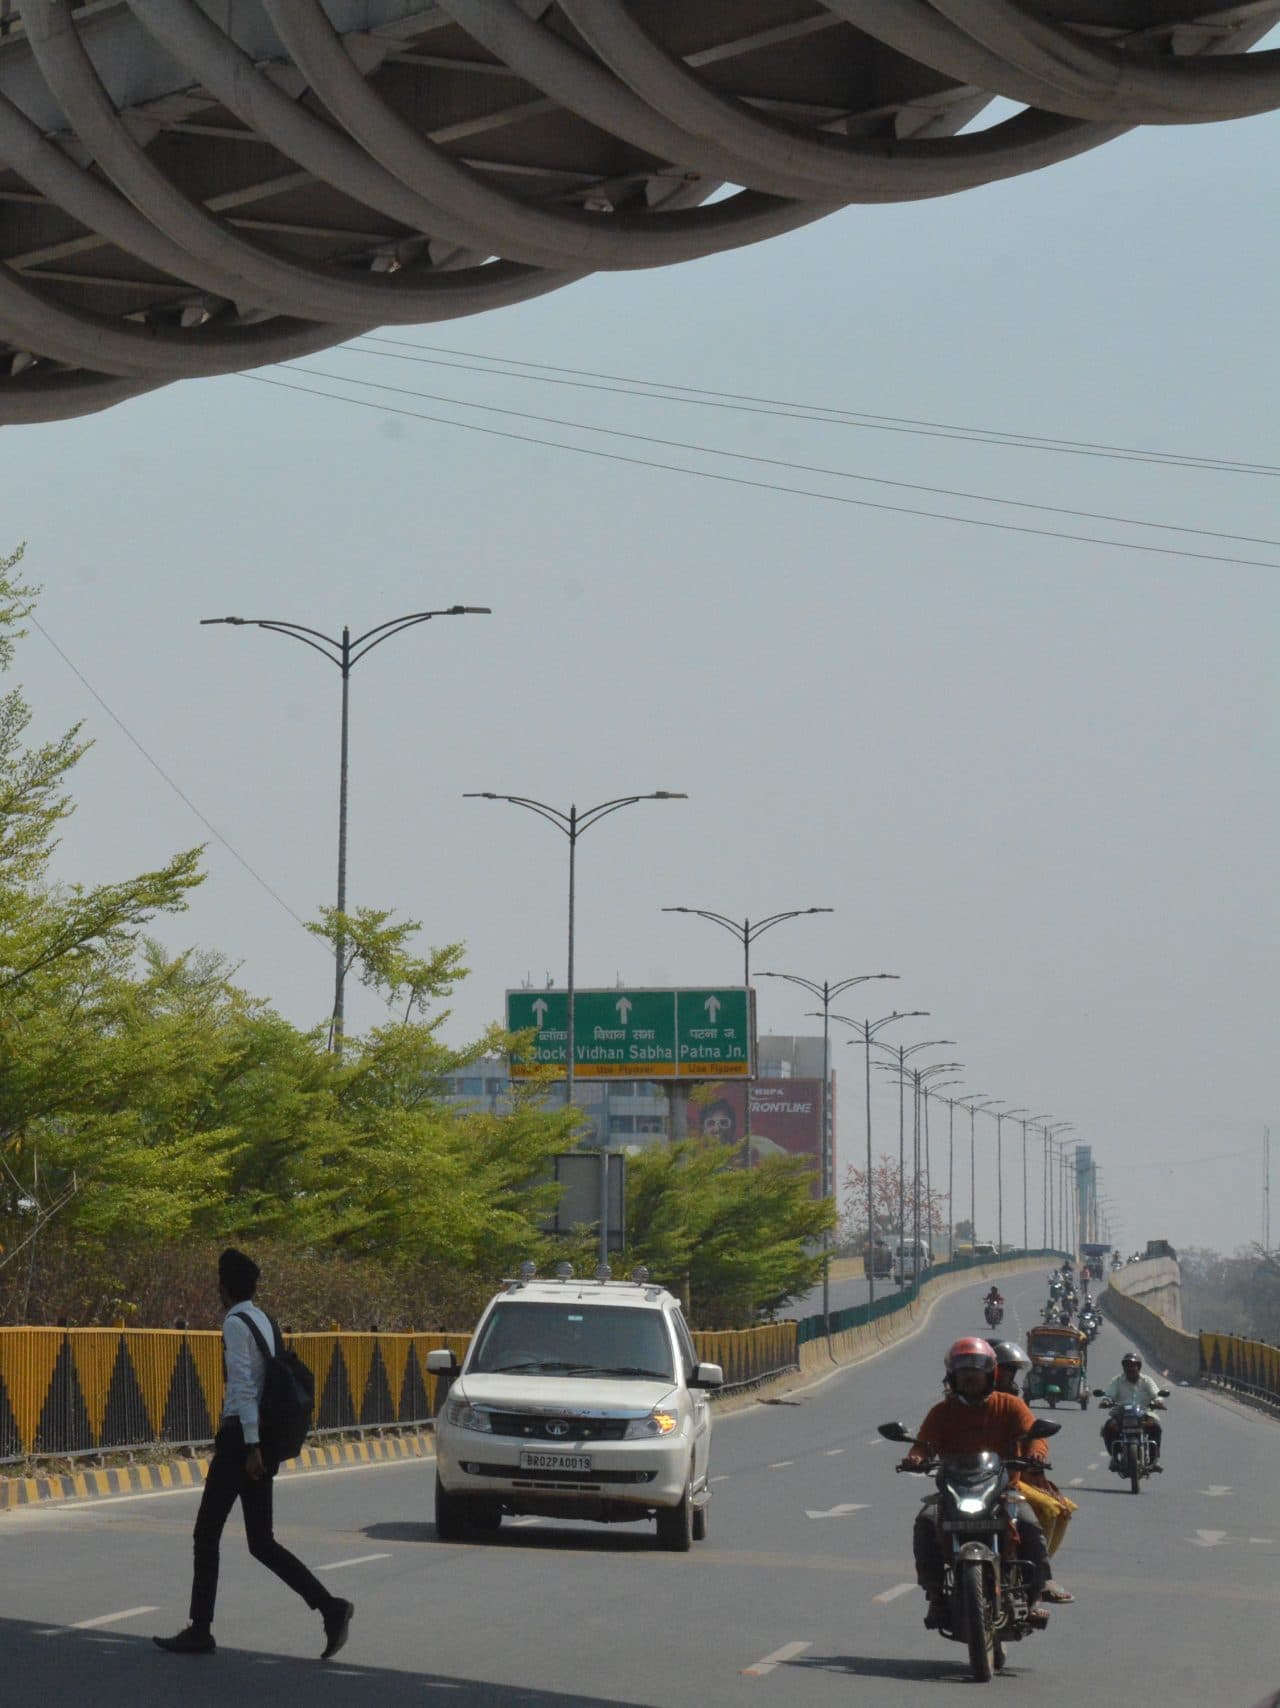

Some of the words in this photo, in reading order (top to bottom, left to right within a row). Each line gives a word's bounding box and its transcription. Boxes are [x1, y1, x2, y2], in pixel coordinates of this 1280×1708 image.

[593, 1026, 626, 1041] विधान
[632, 1029, 656, 1041] सभा
[689, 1028, 718, 1040] पटना
[576, 1045, 624, 1060] Vidhan
[629, 1044, 673, 1060] Sabha
[680, 1044, 721, 1059] Patna
[726, 1044, 745, 1059] Jn.
